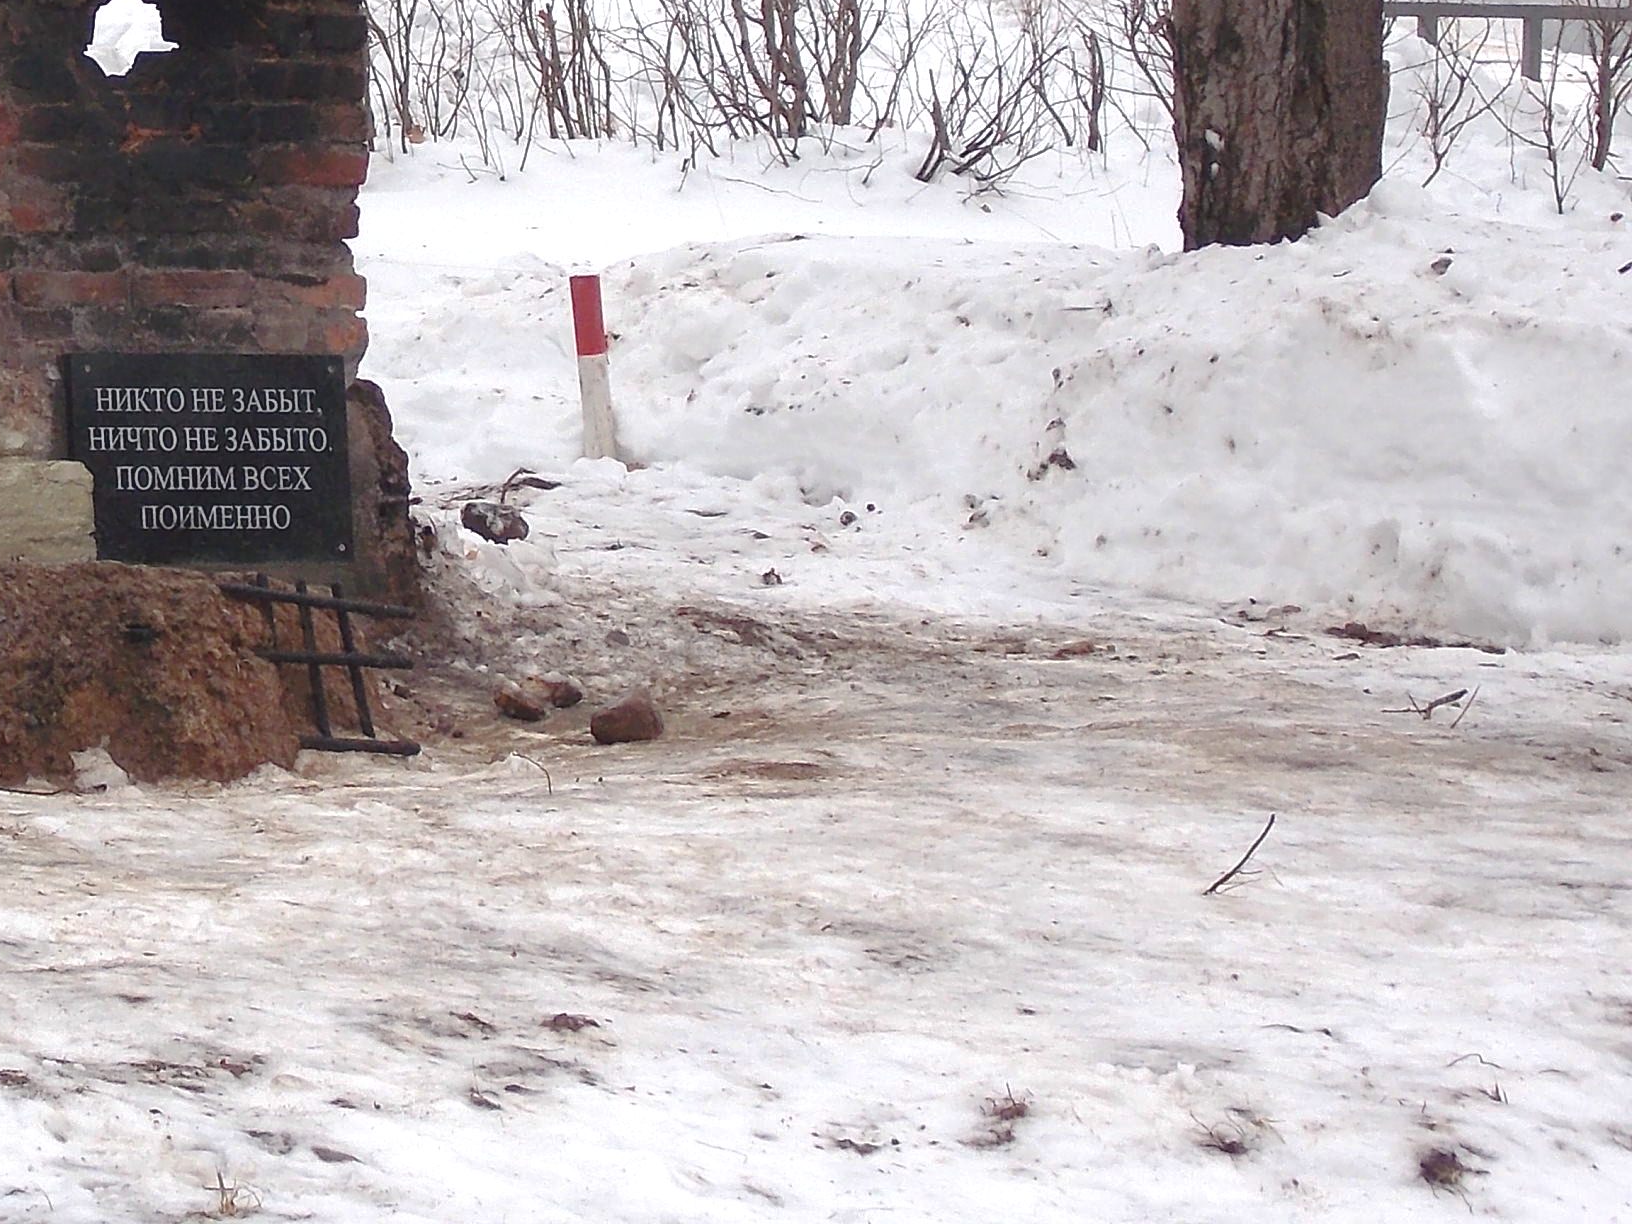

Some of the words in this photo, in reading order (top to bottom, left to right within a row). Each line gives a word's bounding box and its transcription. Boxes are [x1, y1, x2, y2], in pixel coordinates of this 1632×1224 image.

[95, 387, 185, 413] НИКТО
[190, 387, 226, 413] НЕ
[232, 388, 323, 416] ЗАБЫТ,
[88, 426, 178, 452] НИЧТО
[183, 426, 219, 452] НЕ
[225, 427, 334, 453] ЗАБЫТО.
[116, 466, 237, 491] ПОМНИМ
[244, 466, 312, 491] ВСЕХ
[141, 504, 291, 530] ПОИМЕННО
